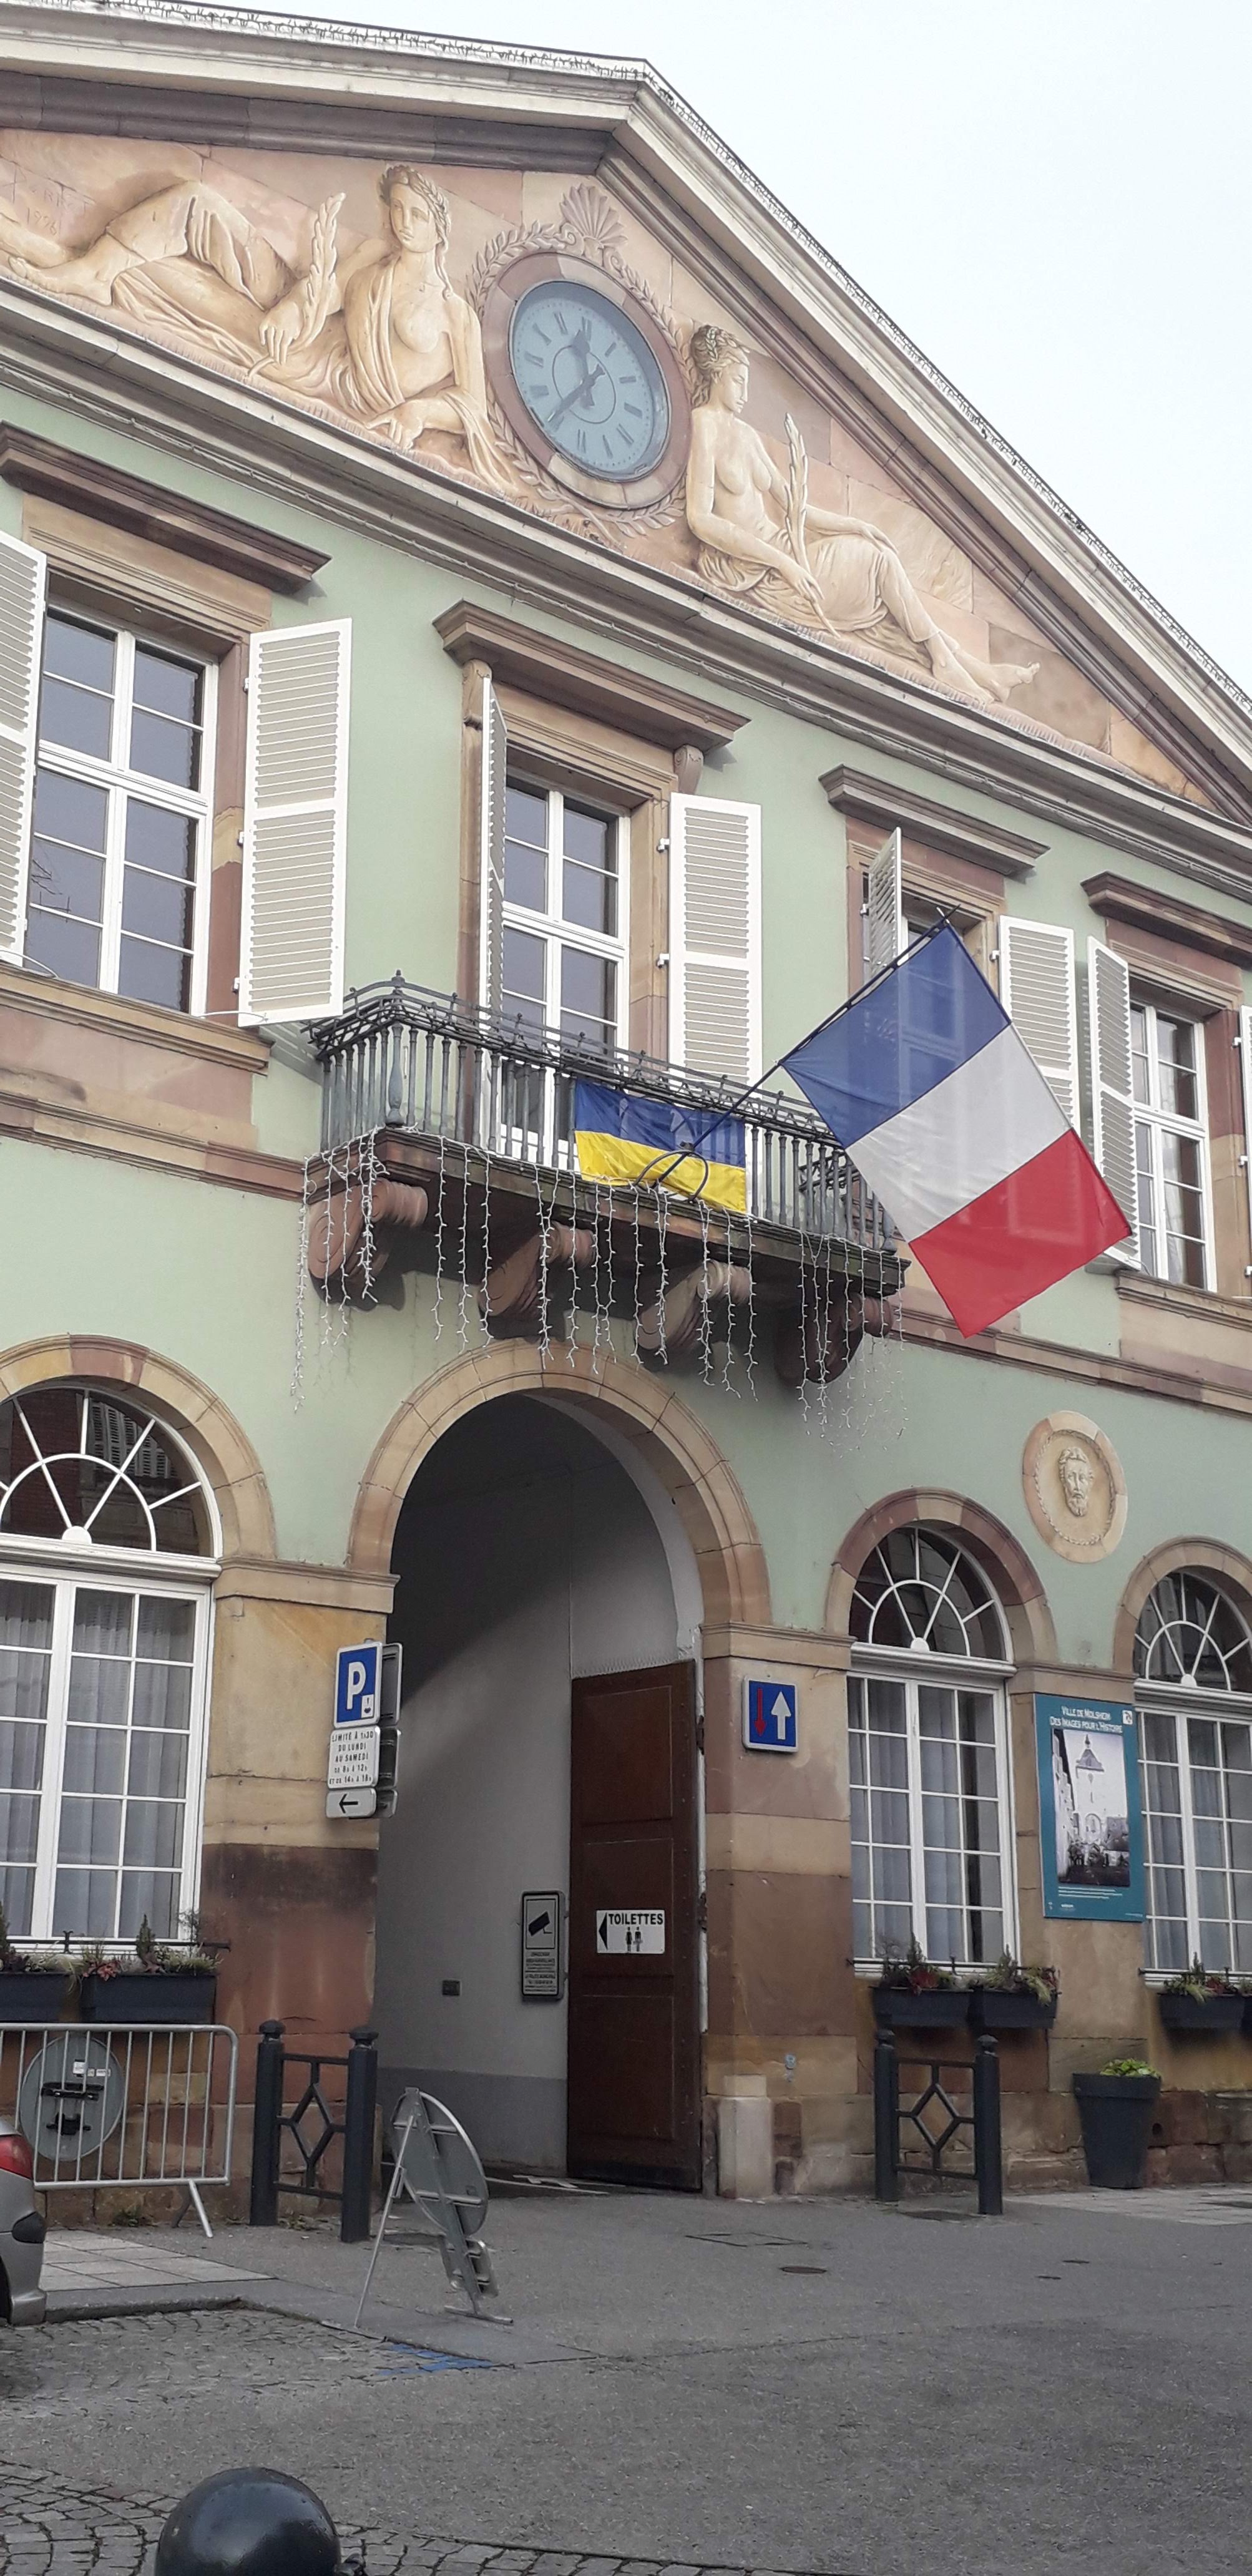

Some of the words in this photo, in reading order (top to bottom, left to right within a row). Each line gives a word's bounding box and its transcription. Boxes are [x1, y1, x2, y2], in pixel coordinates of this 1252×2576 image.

[346, 1661, 366, 1710] P
[1061, 1705, 1076, 1716] VILLE
[338, 1744, 346, 1752] DU
[348, 1742, 366, 1751] LUNDI
[335, 1754, 343, 1763] AU
[345, 1752, 368, 1762] SAMEDI
[608, 1912, 663, 1925] TOILETTES
